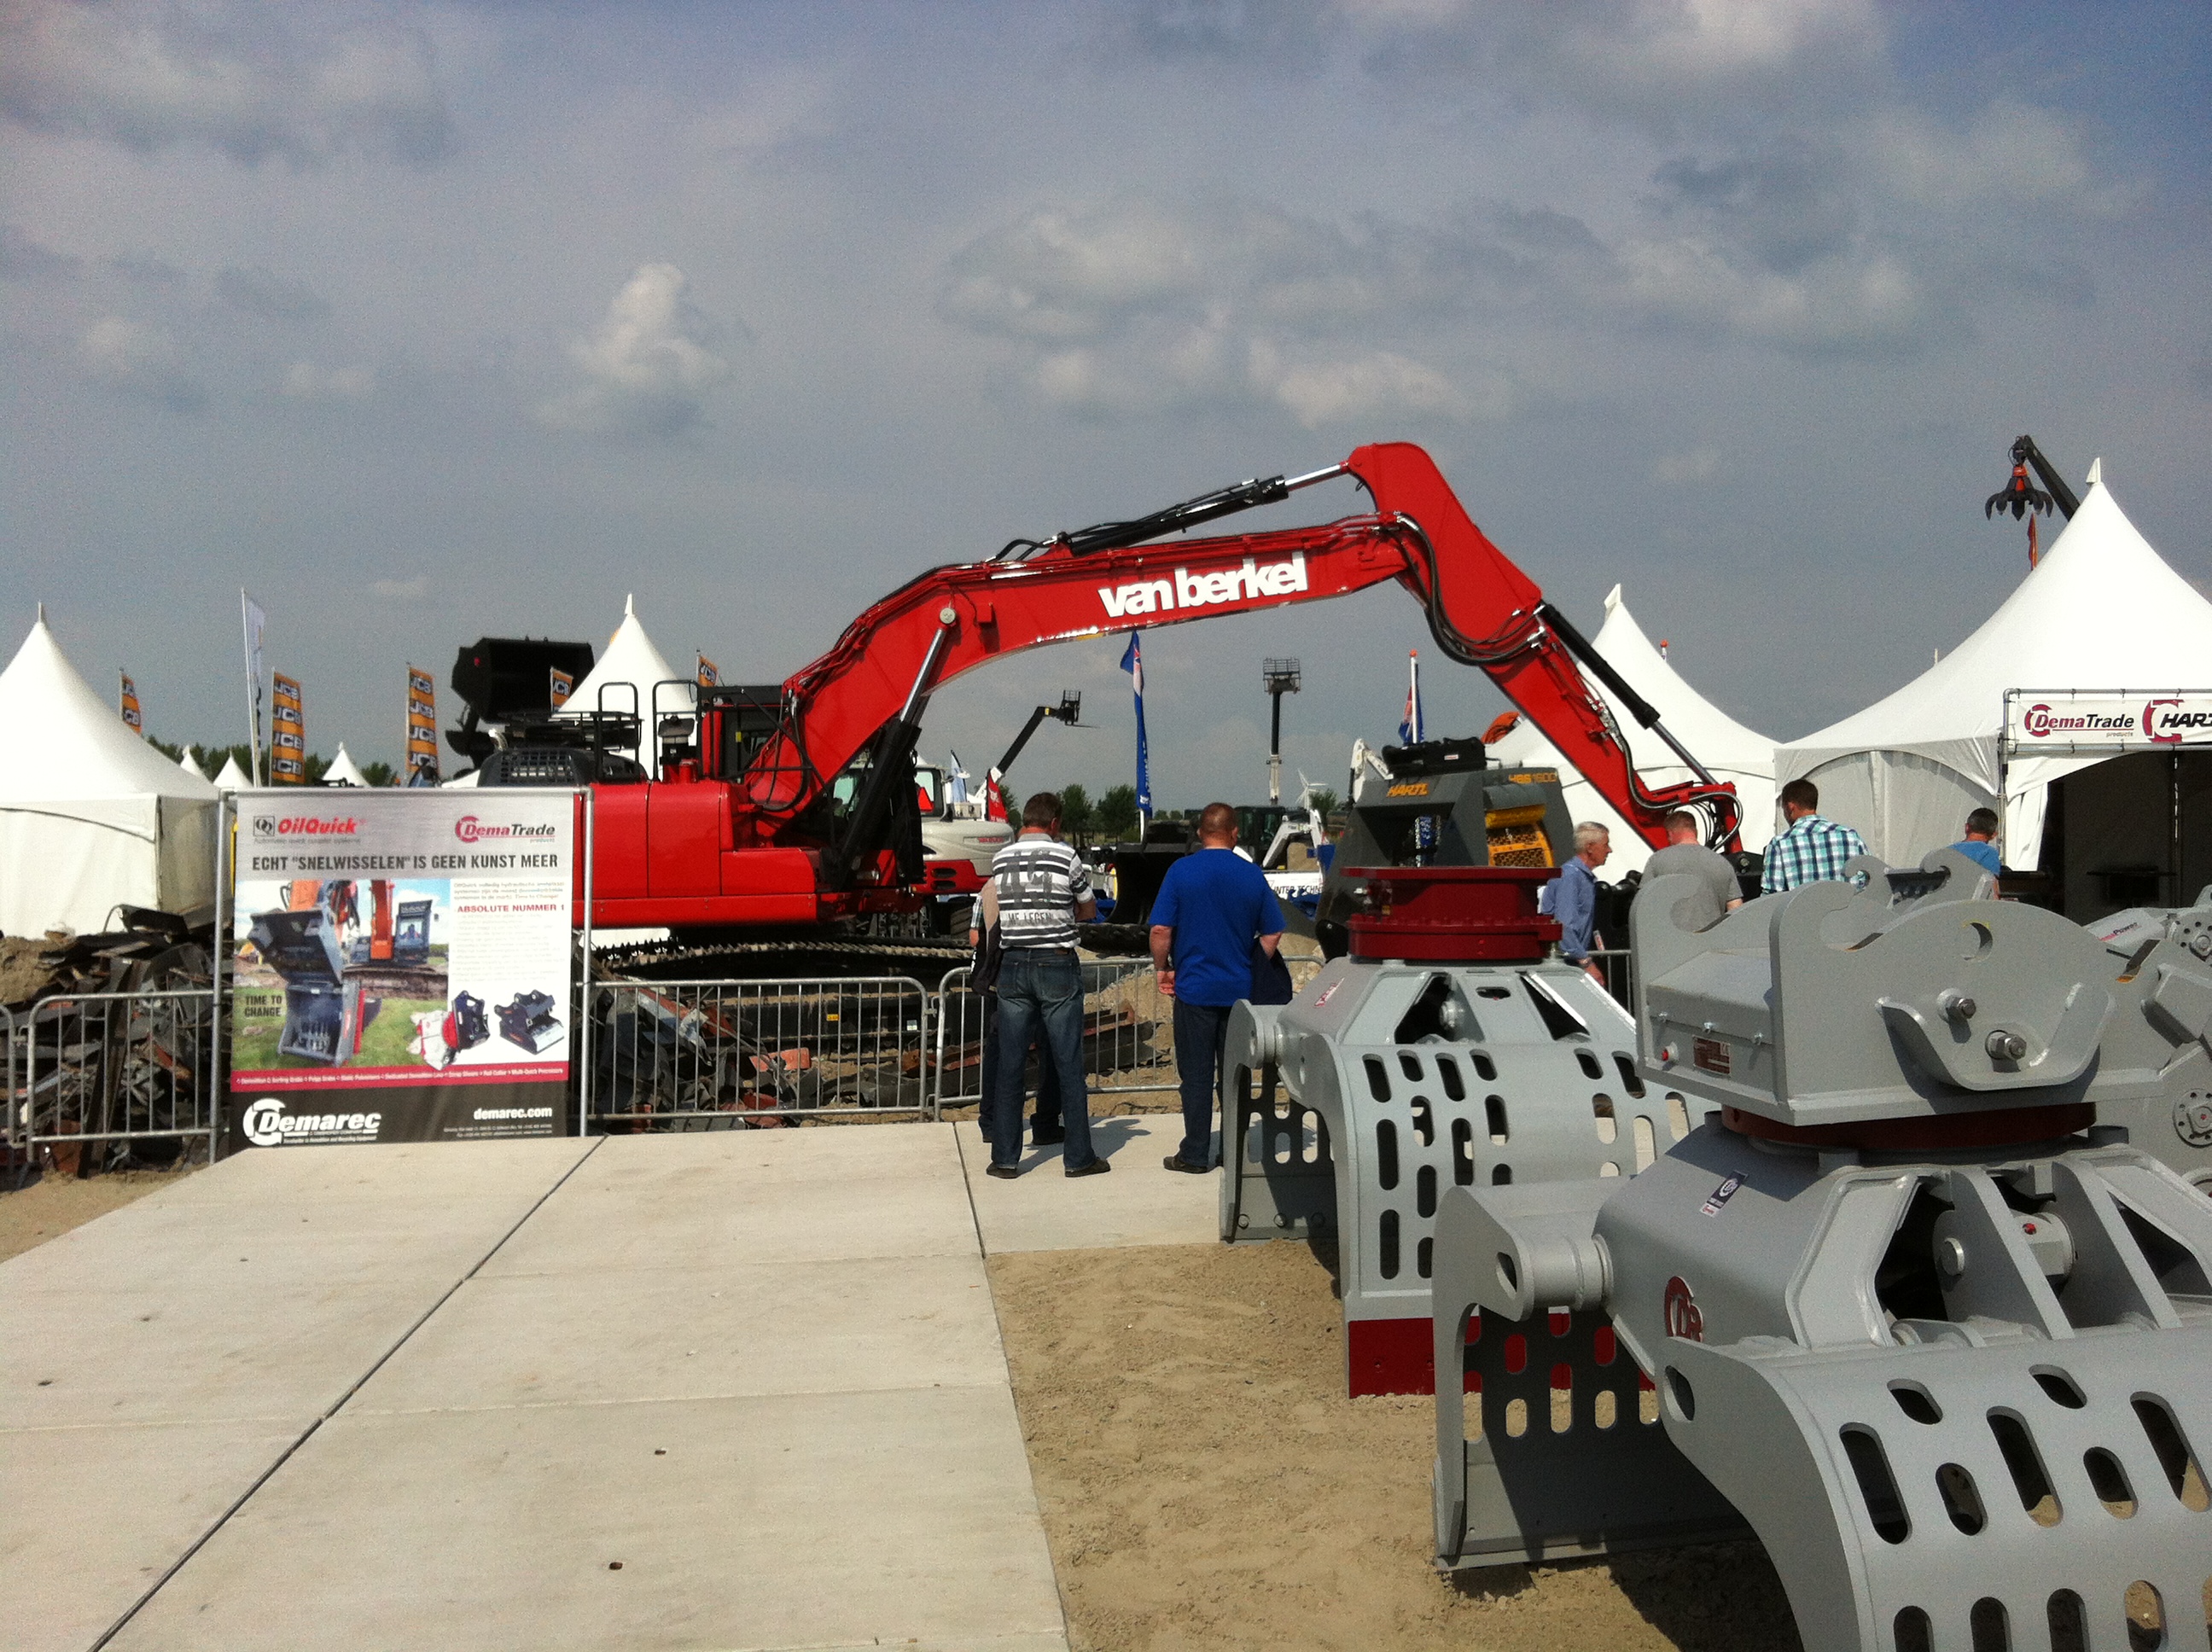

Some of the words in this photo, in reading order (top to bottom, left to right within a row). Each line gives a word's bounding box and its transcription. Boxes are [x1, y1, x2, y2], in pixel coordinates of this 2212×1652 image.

[410, 676, 431, 694] JCB
[410, 701, 434, 718] JCB
[2031, 711, 2134, 731] DemaTrade
[411, 727, 435, 743] JCB
[278, 817, 357, 835] OilQuick
[461, 822, 556, 838] DemaTrade
[253, 857, 288, 870] ECHT
[414, 856, 427, 869] IS
[432, 855, 466, 869] GEEN
[471, 855, 515, 868] KUNST
[521, 854, 557, 868] MEER
[246, 995, 267, 1005] TIME
[271, 995, 282, 1004] TO
[244, 1008, 281, 1017] CHANGE
[474, 1108, 553, 1120] demarec.com
[253, 1109, 382, 1136] Demarec
